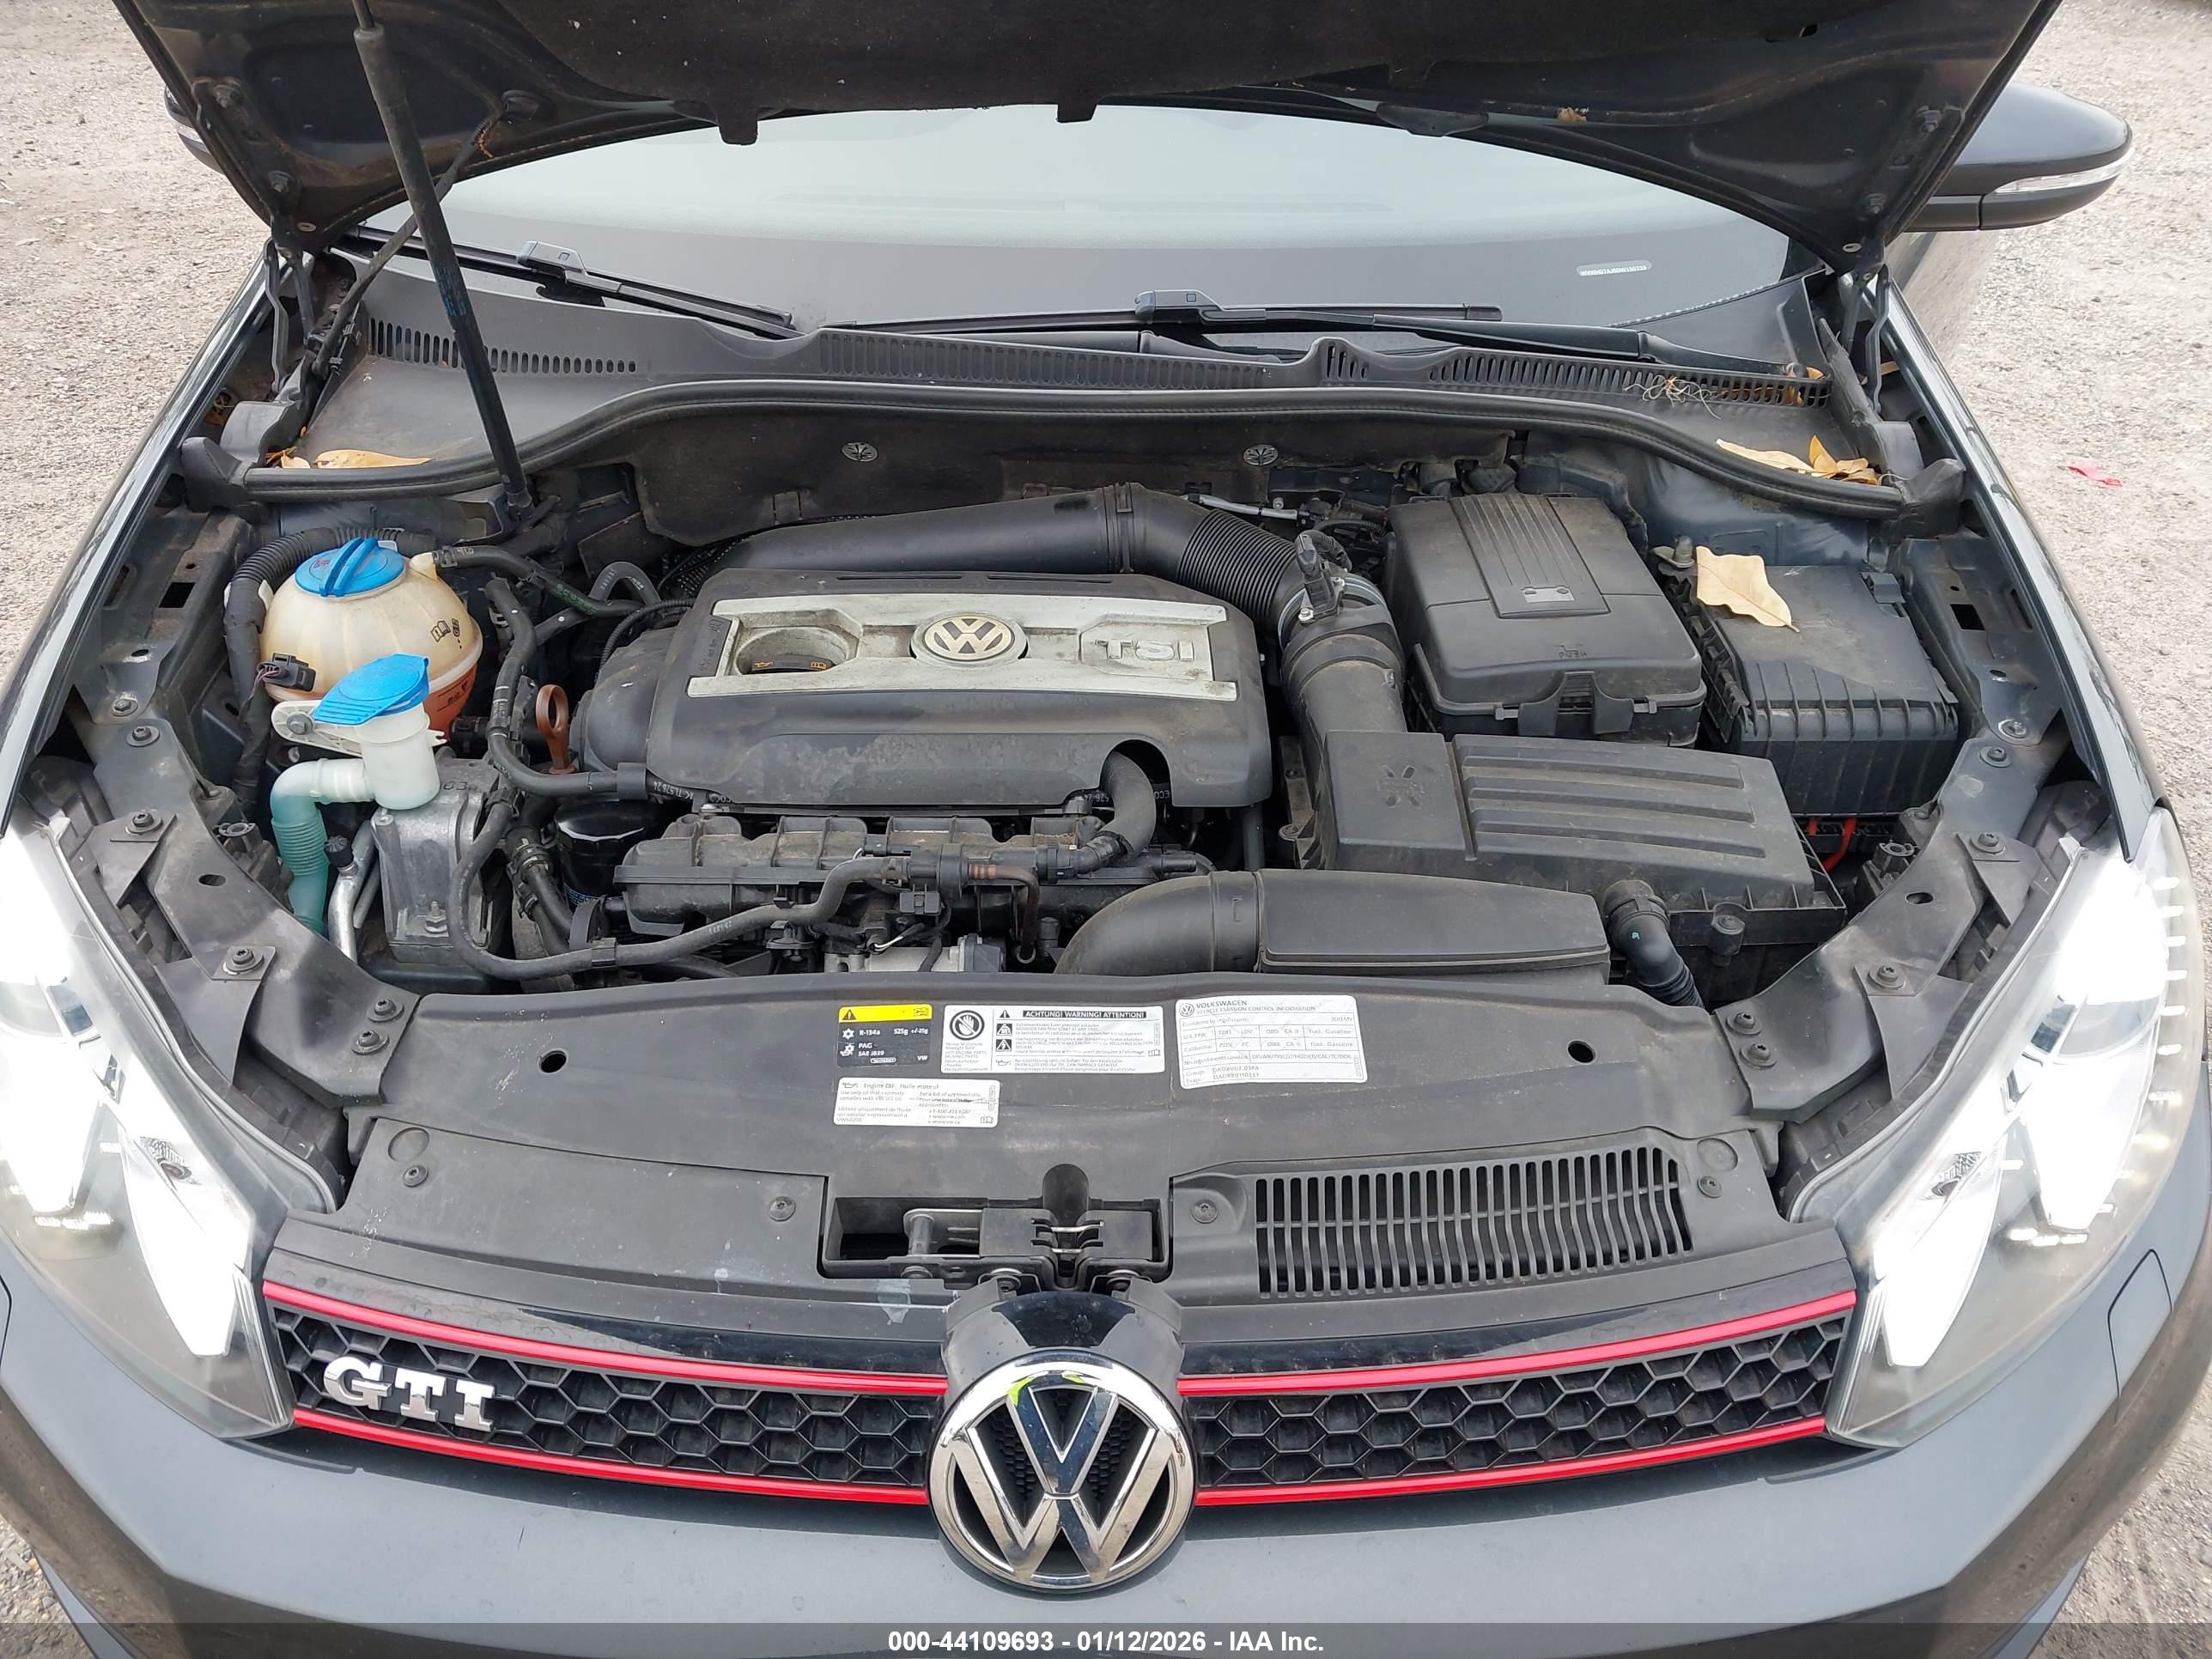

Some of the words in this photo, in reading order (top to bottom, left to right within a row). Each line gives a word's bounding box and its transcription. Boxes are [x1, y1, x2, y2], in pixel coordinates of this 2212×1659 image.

[1095, 639, 1195, 661] TSI
[1195, 1000, 1248, 1009] VOLKSWAGEN
[324, 1356, 495, 1432] GTI
